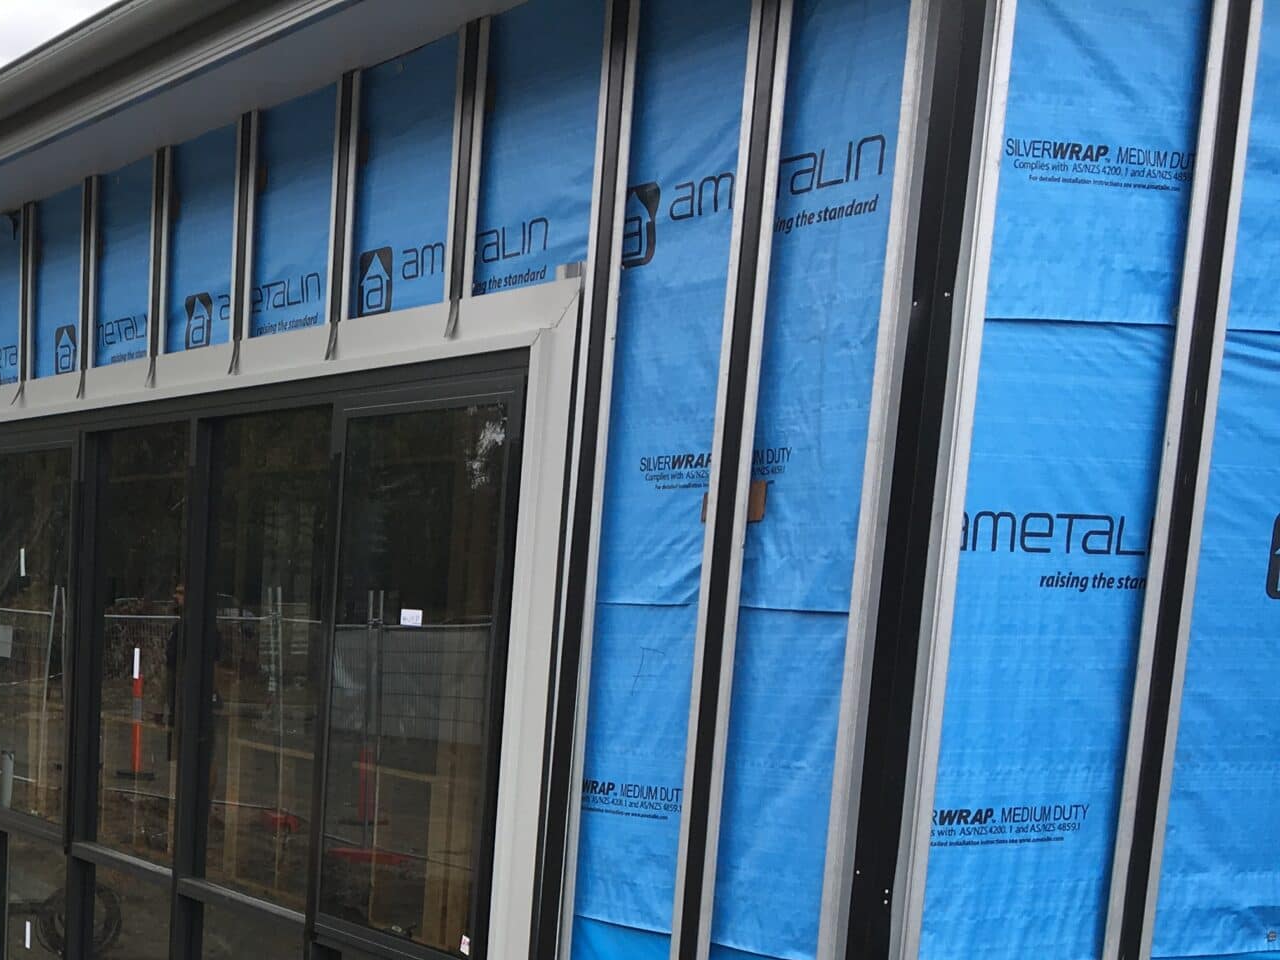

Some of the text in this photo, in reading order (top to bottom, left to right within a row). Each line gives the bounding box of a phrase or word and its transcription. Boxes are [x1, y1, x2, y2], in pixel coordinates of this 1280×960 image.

[1014, 158, 1050, 172] Complies
[1052, 161, 1069, 172] with
[1072, 164, 1100, 175] AS/NZS
[1130, 167, 1145, 178] and
[1117, 146, 1167, 168] MEDIUM
[1170, 151, 1195, 170] DU
[795, 211, 816, 229] the
[816, 194, 879, 222] standard
[488, 275, 503, 289] the
[503, 265, 547, 288] standard
[278, 318, 288, 332] the
[288, 312, 319, 328] standard
[766, 446, 793, 465] DUTY
[1039, 571, 1088, 592] raising
[1091, 571, 1114, 589] the
[620, 783, 658, 801] MEDIUM
[660, 787, 683, 803] DUT
[1000, 805, 1052, 824] MEDIUM
[1053, 803, 1090, 822] DUTY
[937, 827, 956, 837] with
[1015, 823, 1029, 834] and
